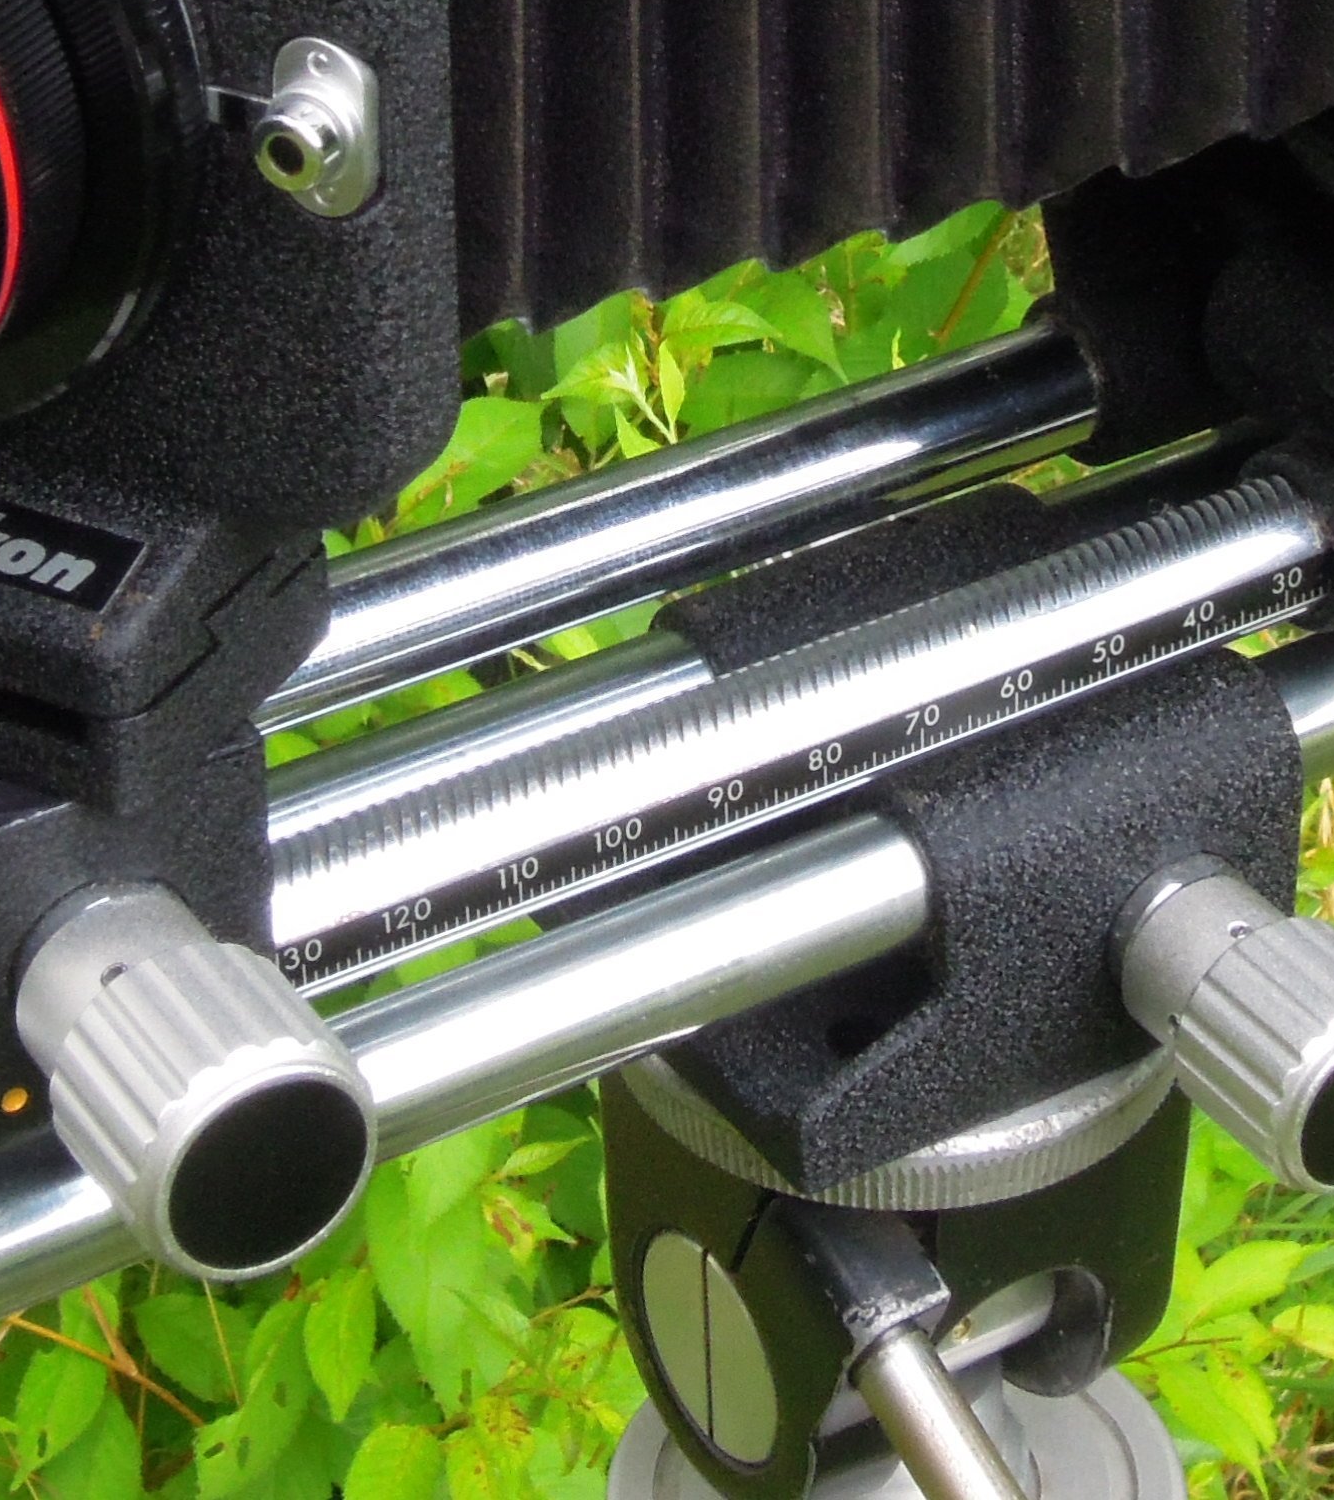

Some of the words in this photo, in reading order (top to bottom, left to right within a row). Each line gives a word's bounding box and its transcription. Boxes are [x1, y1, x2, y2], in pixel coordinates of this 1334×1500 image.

[381, 897, 432, 934] 120
[498, 856, 539, 889] 110
[593, 817, 642, 853] 100
[707, 779, 744, 809] 90
[808, 741, 843, 772] 80
[905, 704, 940, 736] 70
[1000, 669, 1034, 698] 60
[1092, 634, 1125, 663] 50
[1183, 600, 1215, 628] 40
[1271, 566, 1303, 594] 30
